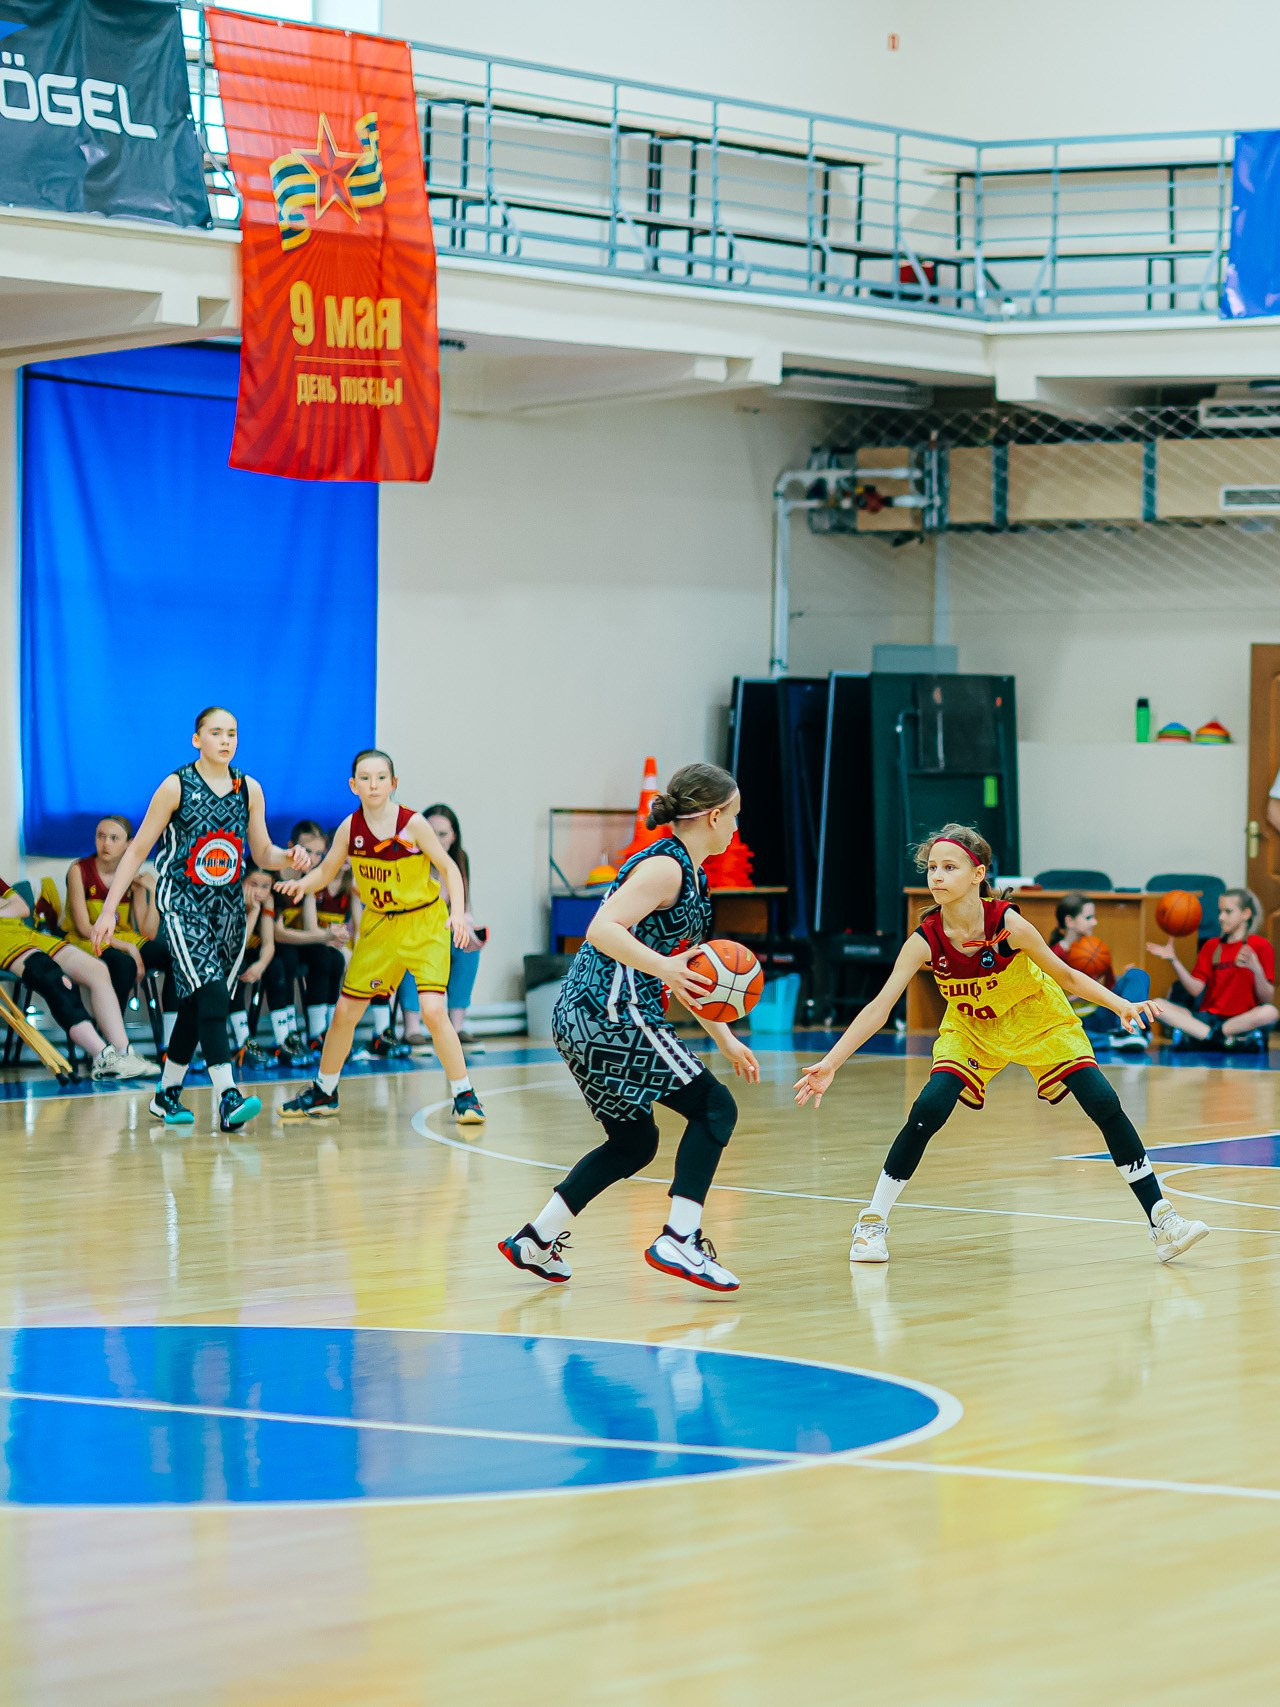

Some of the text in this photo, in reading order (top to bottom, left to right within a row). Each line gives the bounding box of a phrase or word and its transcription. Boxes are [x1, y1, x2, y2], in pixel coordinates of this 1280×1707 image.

[289, 280, 402, 350] 9 мая
[297, 373, 402, 409] ДЕНЬ ПОБЕДЫ
